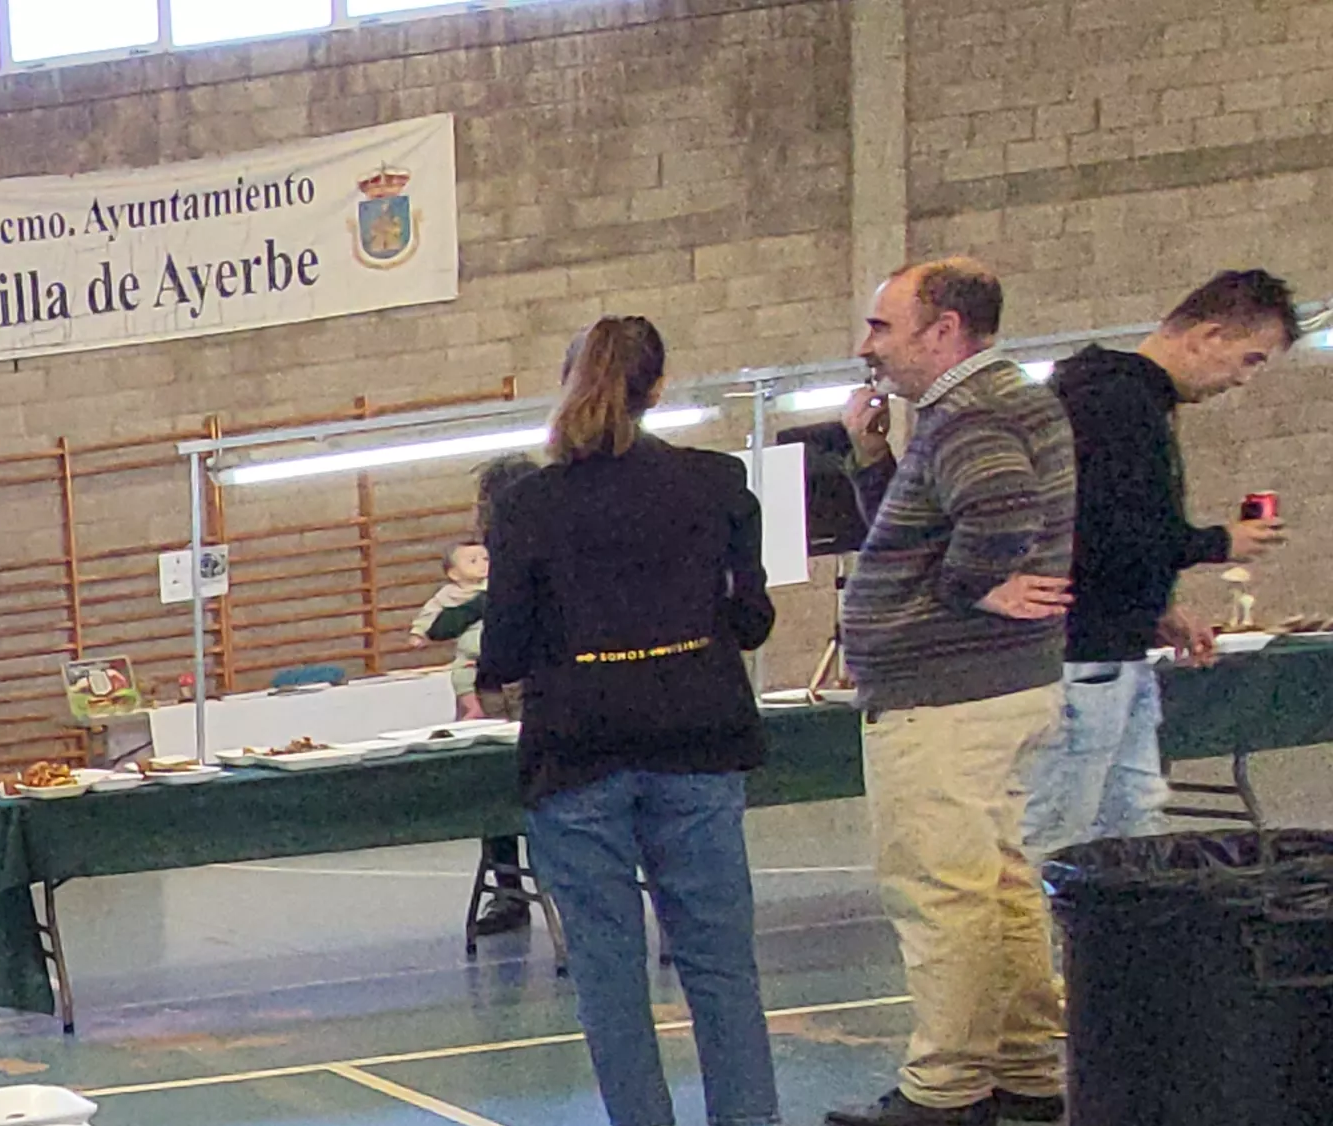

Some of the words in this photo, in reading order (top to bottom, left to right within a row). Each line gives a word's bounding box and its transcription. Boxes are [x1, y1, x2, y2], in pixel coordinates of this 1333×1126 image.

[84, 171, 316, 242] Ayuntamiento
[87, 261, 140, 315] de
[152, 238, 321, 319] Ayerbe
